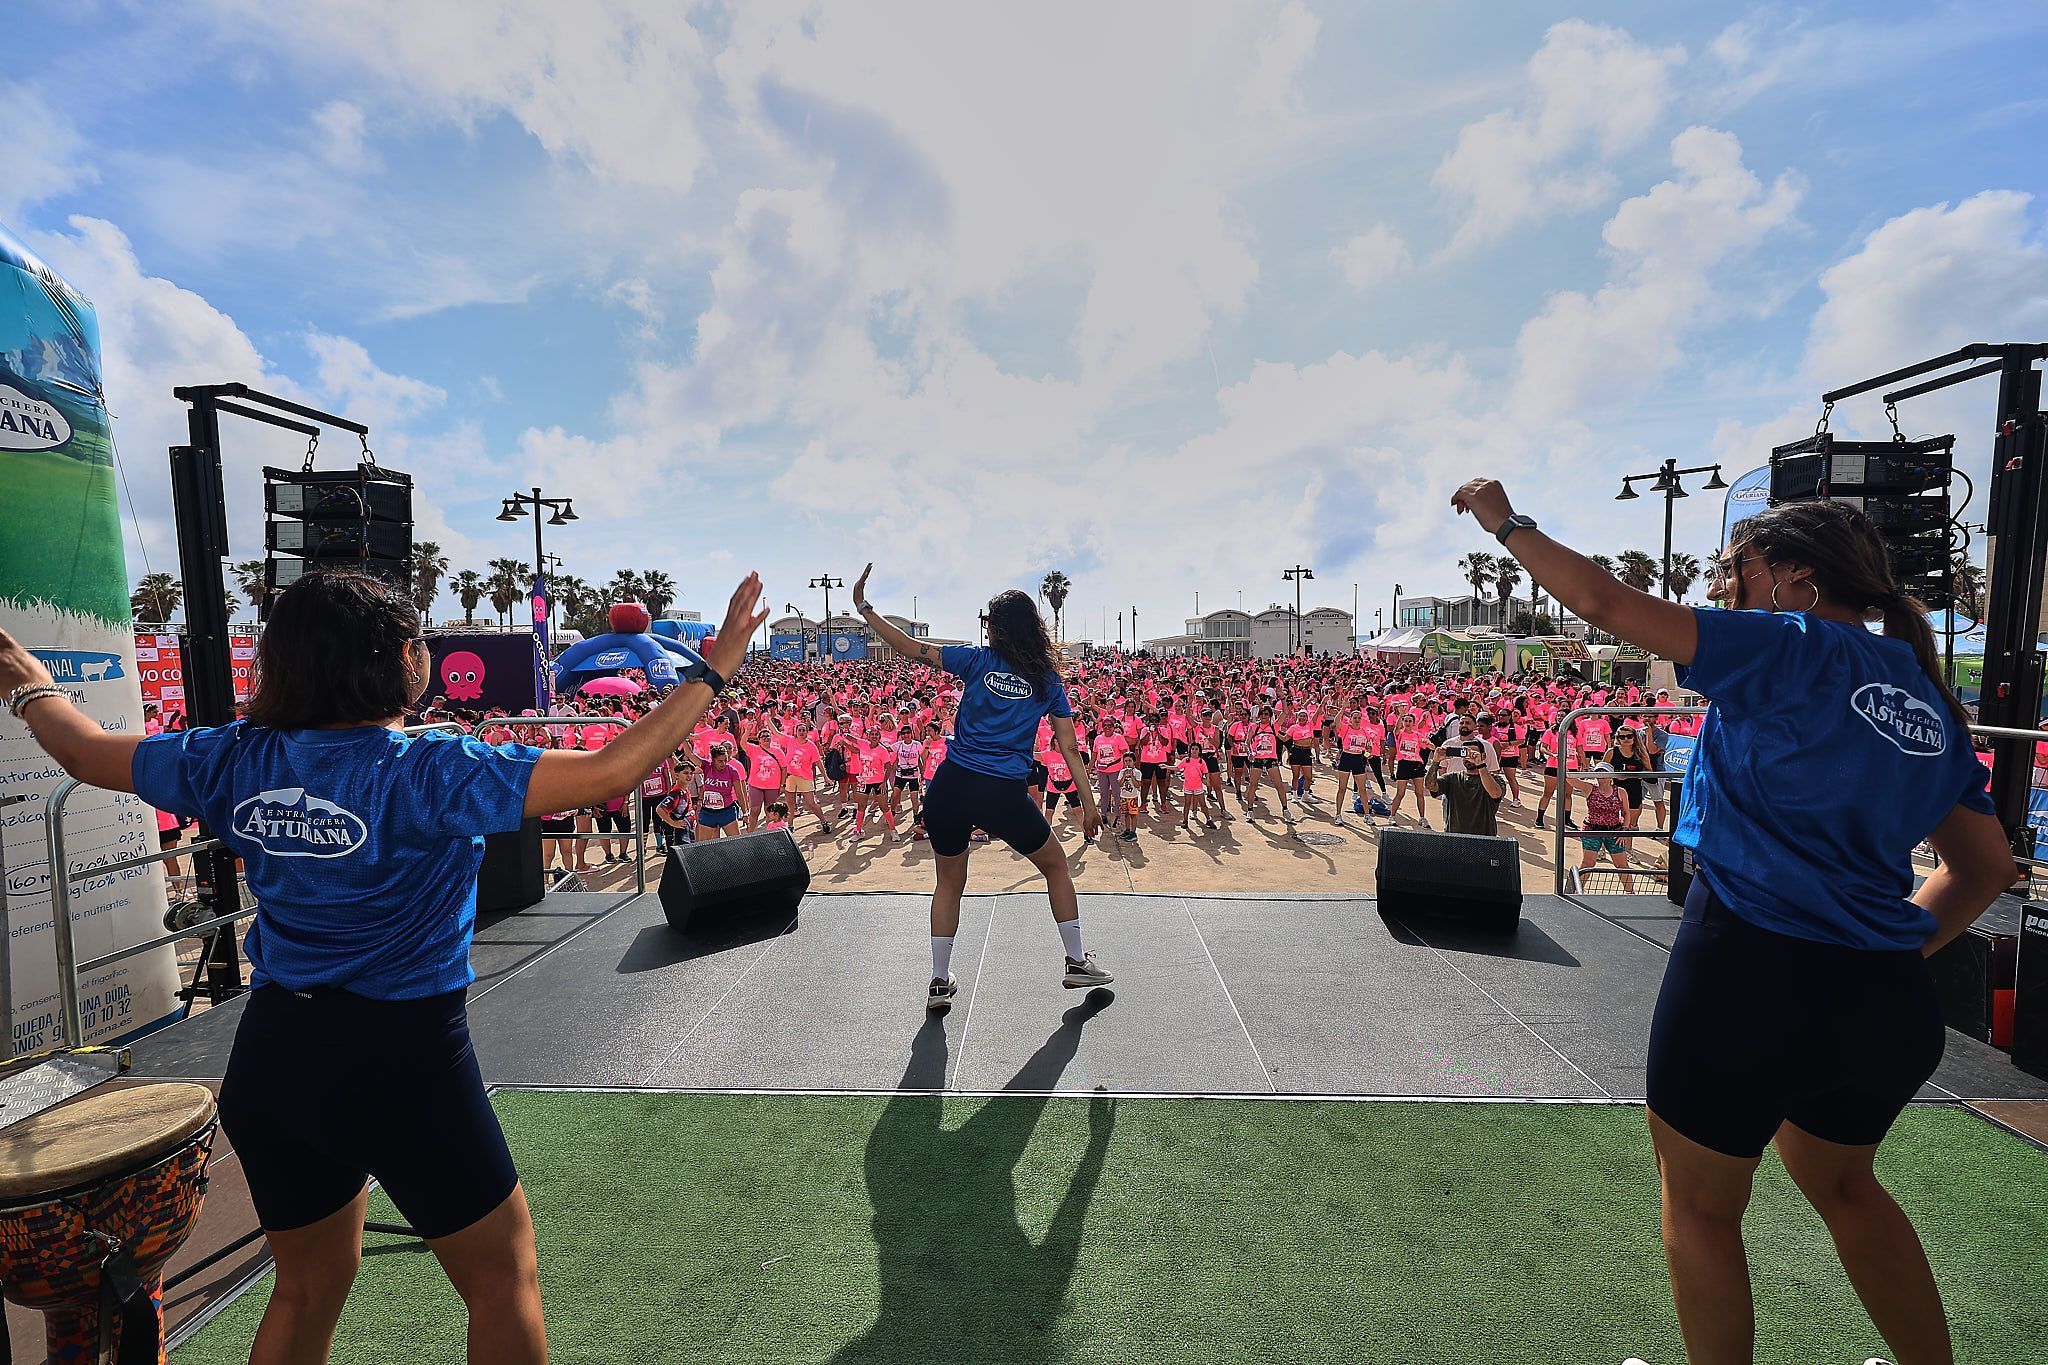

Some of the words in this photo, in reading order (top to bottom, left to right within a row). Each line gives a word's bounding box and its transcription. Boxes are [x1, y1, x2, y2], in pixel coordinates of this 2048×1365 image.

[0, 397, 51, 417] CHERA
[0, 409, 61, 442] ANA
[987, 675, 1028, 696] ASTURIANA
